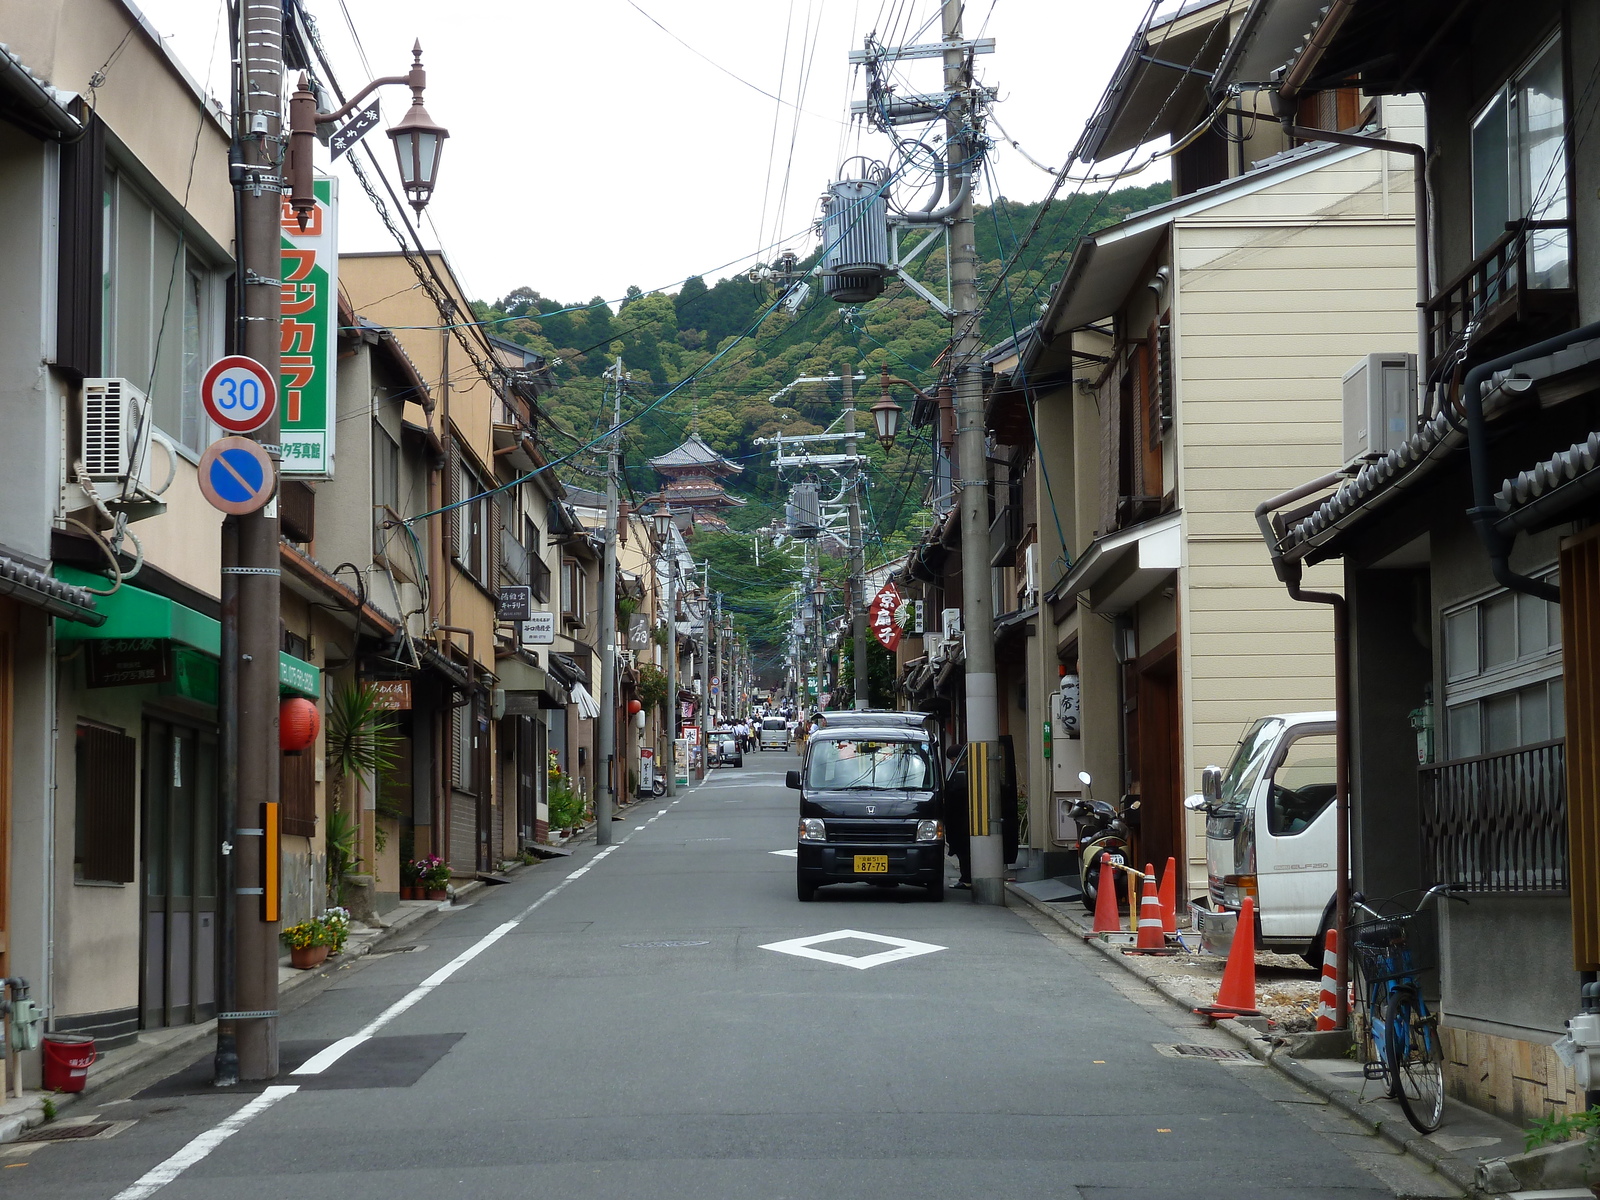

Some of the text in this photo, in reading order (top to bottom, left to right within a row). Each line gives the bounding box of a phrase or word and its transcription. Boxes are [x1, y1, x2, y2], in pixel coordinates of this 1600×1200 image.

[333, 109, 379, 150] 茶わん坂
[280, 249, 317, 422] フジカラー
[219, 378, 258, 410] 30
[280, 442, 321, 459] タ写真館
[874, 590, 896, 643] 京扇子
[861, 862, 887, 872] 87-75
